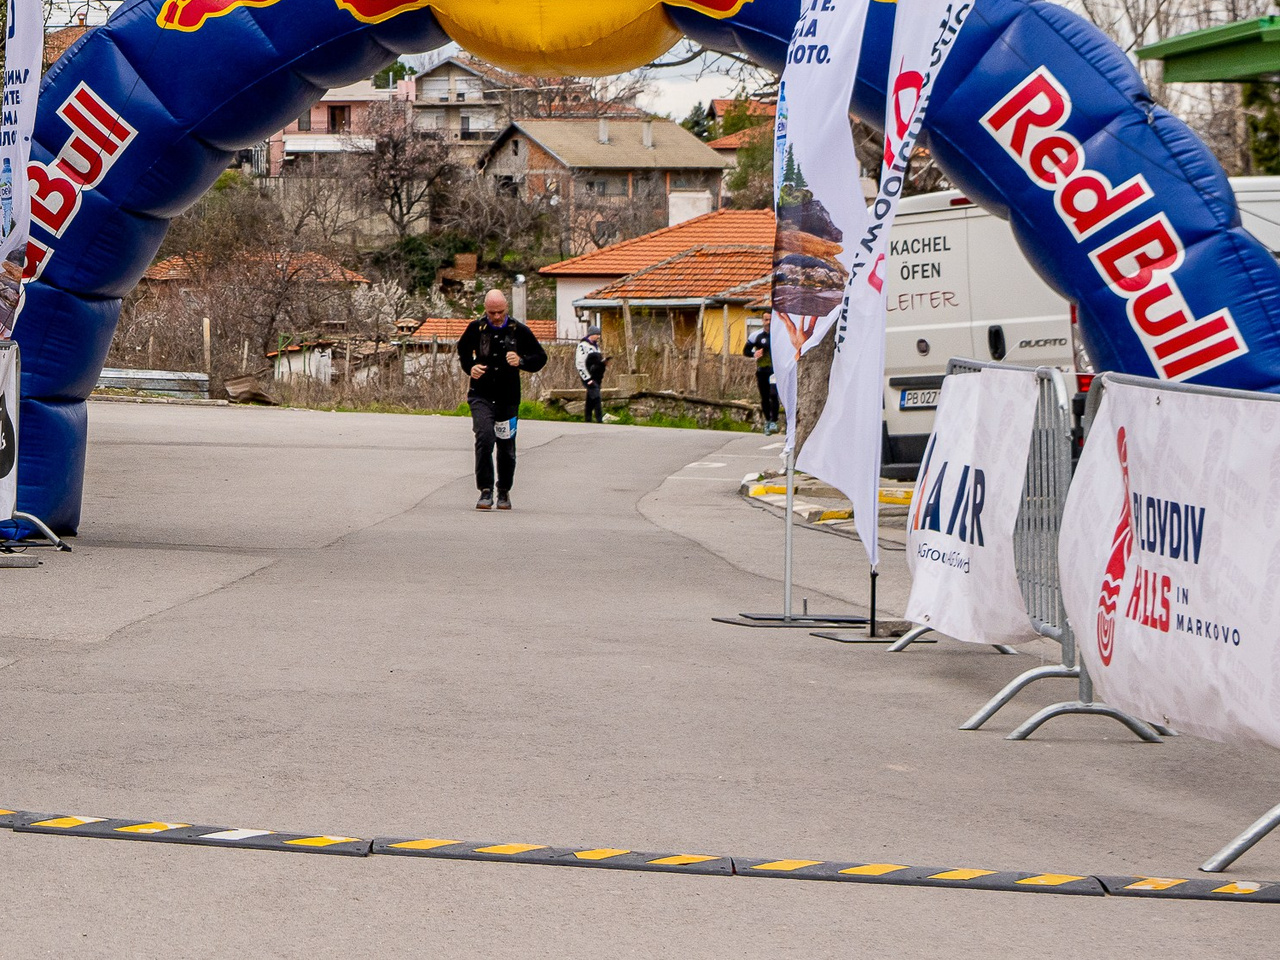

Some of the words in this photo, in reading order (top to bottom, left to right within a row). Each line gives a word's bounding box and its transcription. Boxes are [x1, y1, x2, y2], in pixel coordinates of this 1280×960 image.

[26, 86, 132, 234] Bull
[988, 72, 1146, 236] Red
[890, 236, 951, 257] KACHEL
[900, 261, 941, 281] ÖFEN
[886, 291, 960, 312] LEITER
[1093, 219, 1240, 381] Bull
[1019, 337, 1069, 349] DUCATO
[906, 391, 919, 405] PB
[920, 390, 942, 404] 027
[1176, 586, 1189, 605] IN
[1176, 614, 1241, 647] MARKOVO
